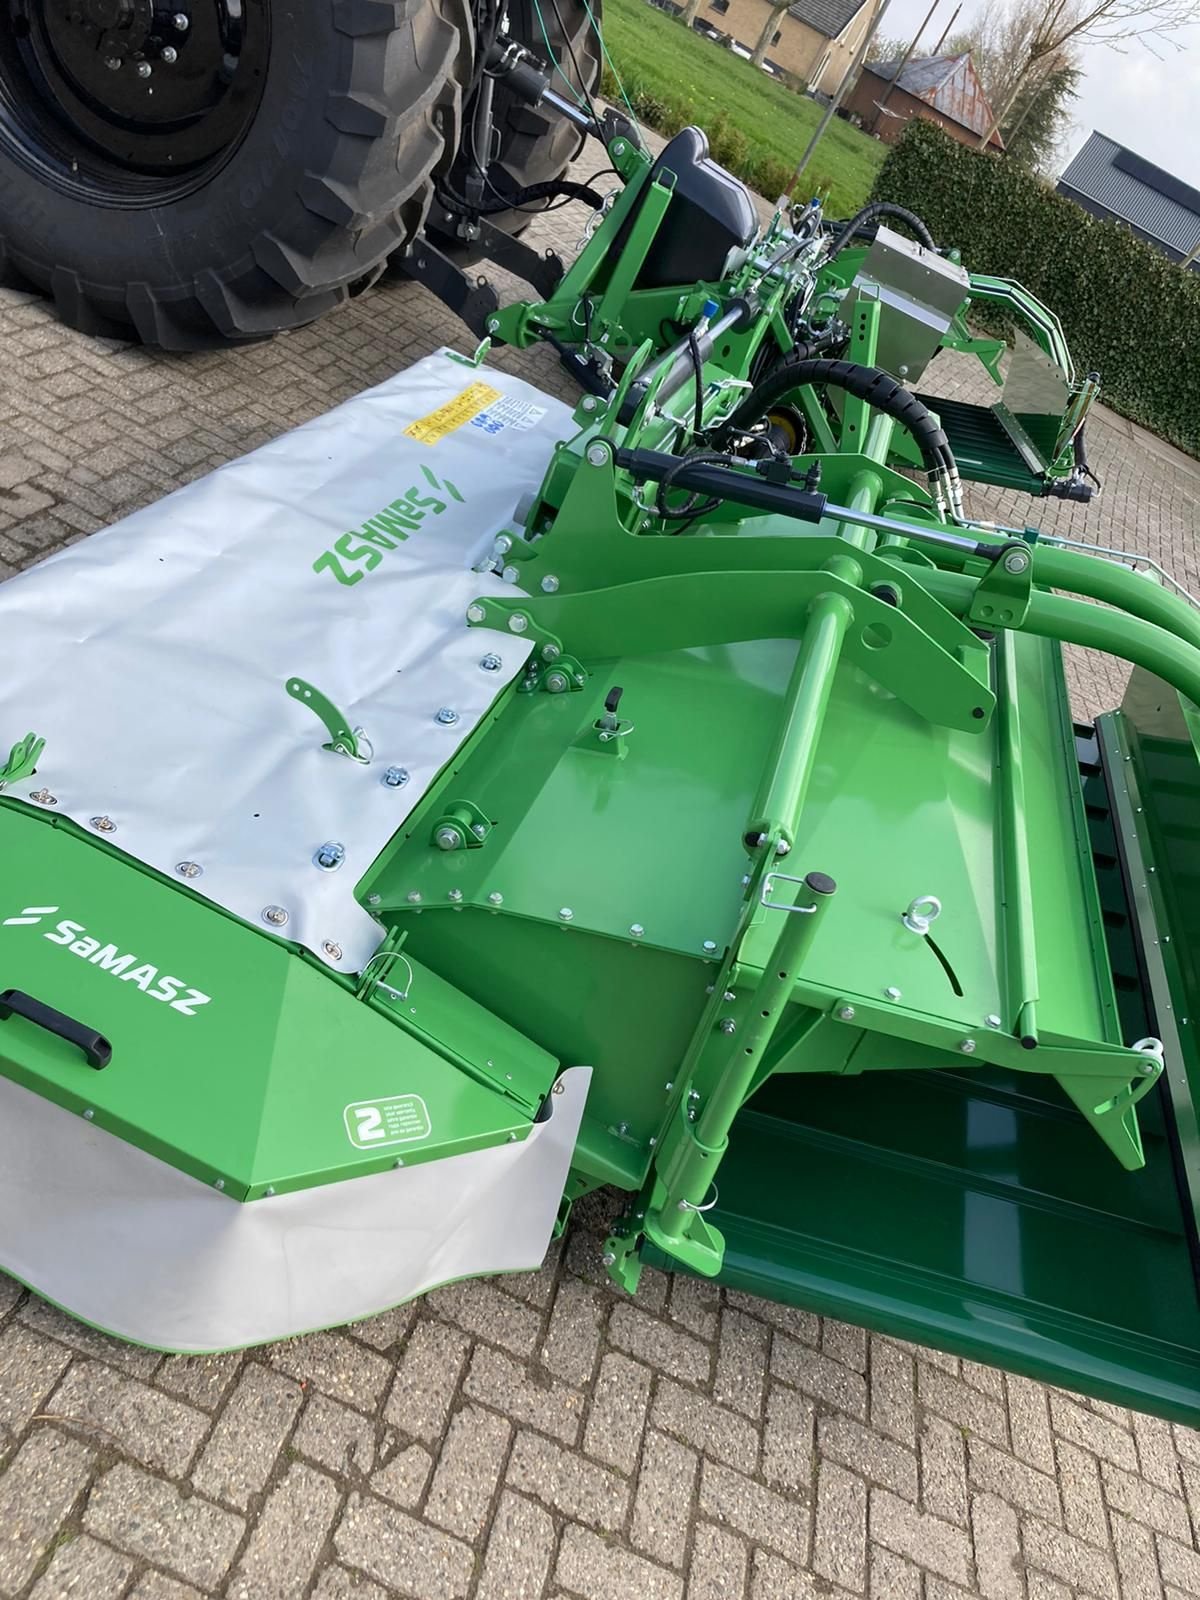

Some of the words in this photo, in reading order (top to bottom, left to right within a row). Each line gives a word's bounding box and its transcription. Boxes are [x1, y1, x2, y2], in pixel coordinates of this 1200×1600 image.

[312, 486, 447, 586] SaMASZ
[43, 919, 212, 1016] SaMASZ
[354, 1107, 386, 1142] 2
